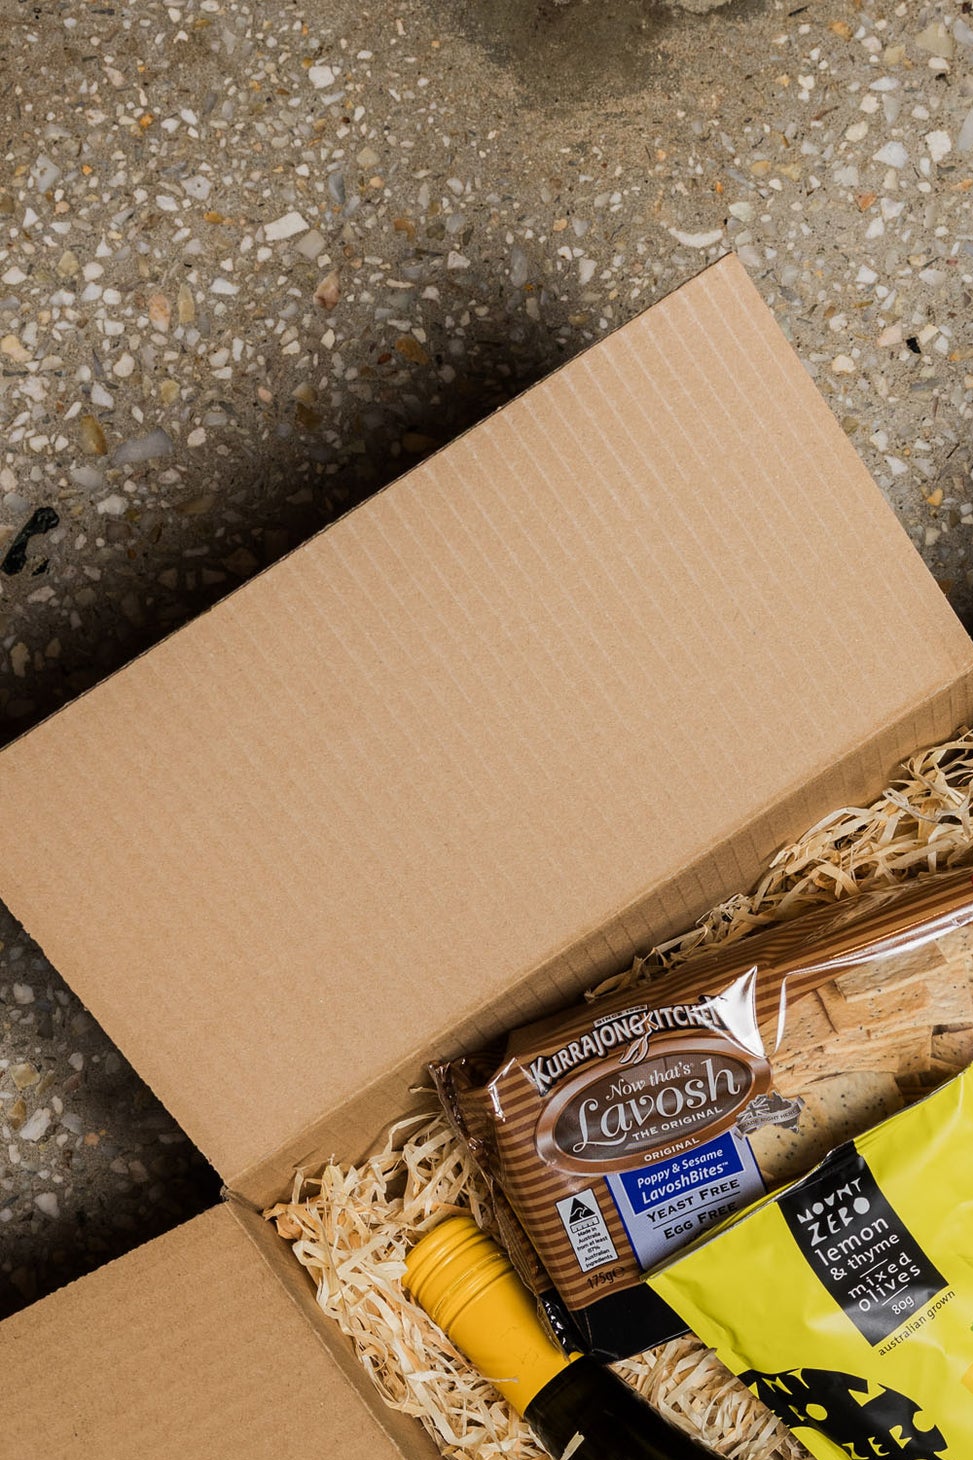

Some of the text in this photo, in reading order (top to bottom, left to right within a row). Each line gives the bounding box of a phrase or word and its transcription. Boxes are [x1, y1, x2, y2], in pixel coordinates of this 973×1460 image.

[530, 1014, 646, 1092] KURRAJONG
[606, 1062, 692, 1100] Now that's
[572, 1058, 741, 1153] Lavosh
[632, 1106, 724, 1142] THE ORIGINAL
[636, 1148, 724, 1189] Poppy & Sesame
[643, 1137, 701, 1163] ORIGINAL
[646, 1178, 741, 1224] YEAST FREE
[663, 1201, 740, 1241] EGG FREE
[796, 1177, 862, 1225] MOUNT
[807, 1196, 871, 1248] ZERO
[578, 1228, 591, 1237] Made
[578, 1232, 602, 1244] Australia
[595, 1236, 609, 1244] least
[814, 1218, 890, 1267] lemon
[584, 1248, 610, 1262] Australian
[830, 1233, 900, 1281] & thyme
[847, 1252, 913, 1300] mixed
[858, 1264, 922, 1313] olives
[891, 1294, 916, 1315] 80g
[878, 1289, 957, 1357] australian grown
